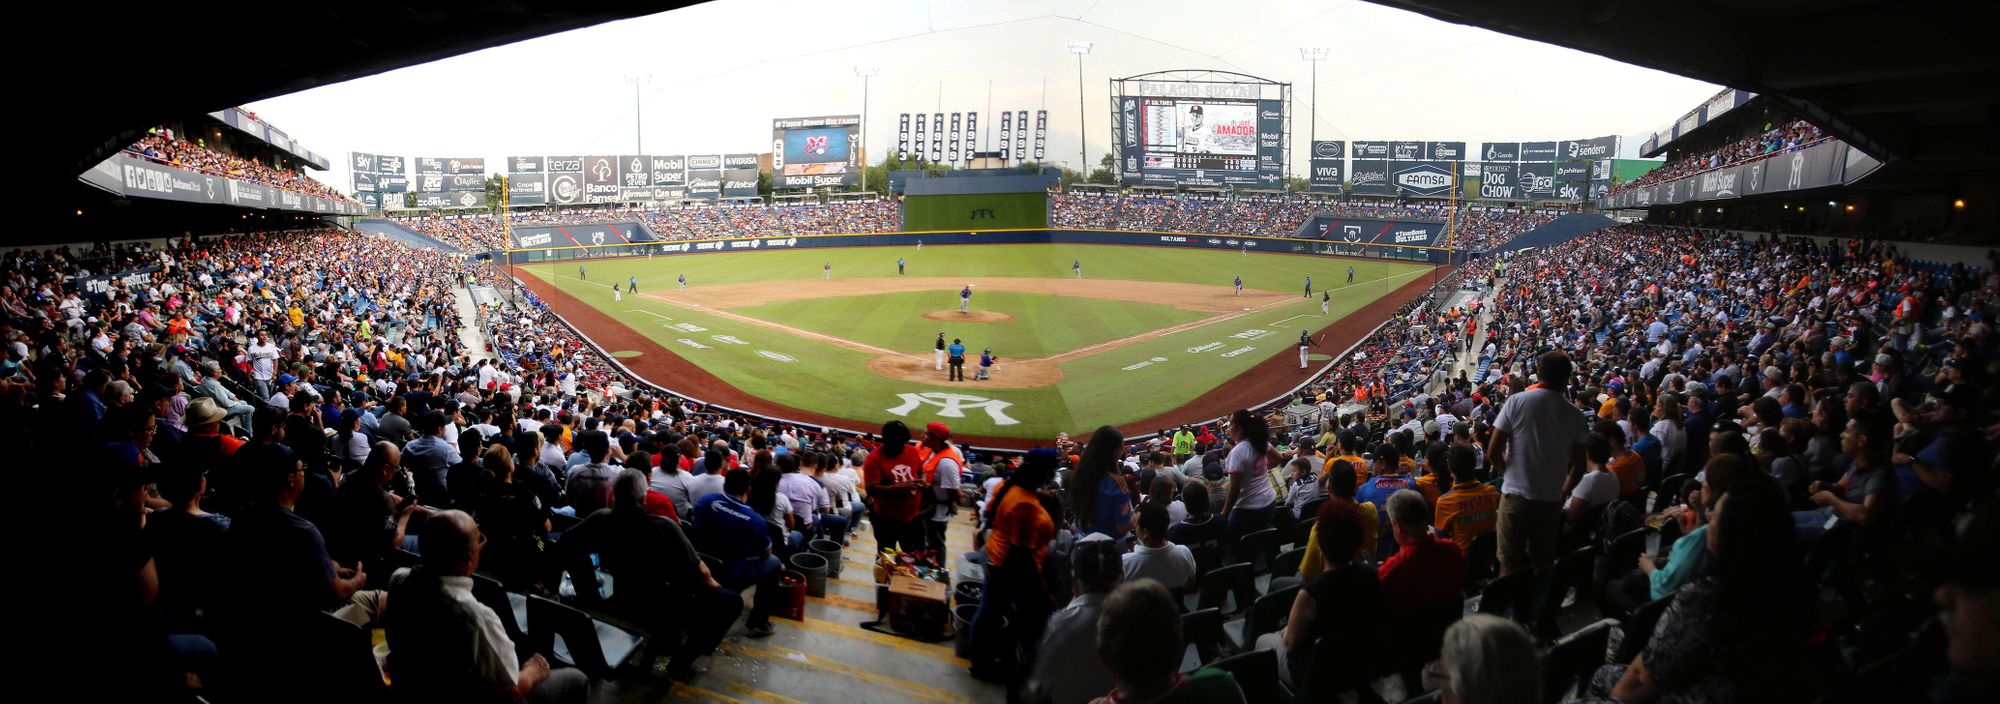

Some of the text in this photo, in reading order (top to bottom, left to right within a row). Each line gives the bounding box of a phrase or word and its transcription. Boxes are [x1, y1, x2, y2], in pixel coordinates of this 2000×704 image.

[1216, 125, 1255, 136] AMADOR
[899, 123, 908, 161] 1943
[915, 123, 924, 161] 1947
[932, 123, 942, 161] 1948
[949, 122, 959, 160] 1949
[966, 121, 976, 160] 1962
[1000, 120, 1009, 159] 1991
[1016, 120, 1026, 158] 1995
[1035, 119, 1046, 158] 1996
[1579, 145, 1606, 156] sendero
[357, 154, 371, 171] sky
[548, 158, 579, 170] terza
[654, 160, 683, 170] Mobil
[655, 172, 682, 180] Super
[1316, 167, 1338, 176] viva
[786, 176, 842, 186] Mobil Super
[1406, 175, 1444, 184] FAMSA
[1483, 172, 1505, 185] DOG
[1702, 171, 1736, 192] Mobil Super
[587, 184, 617, 192] Banco
[1481, 185, 1515, 198] CHOW
[1560, 185, 1578, 200] sky
[1376, 478, 1409, 488] TECATE
